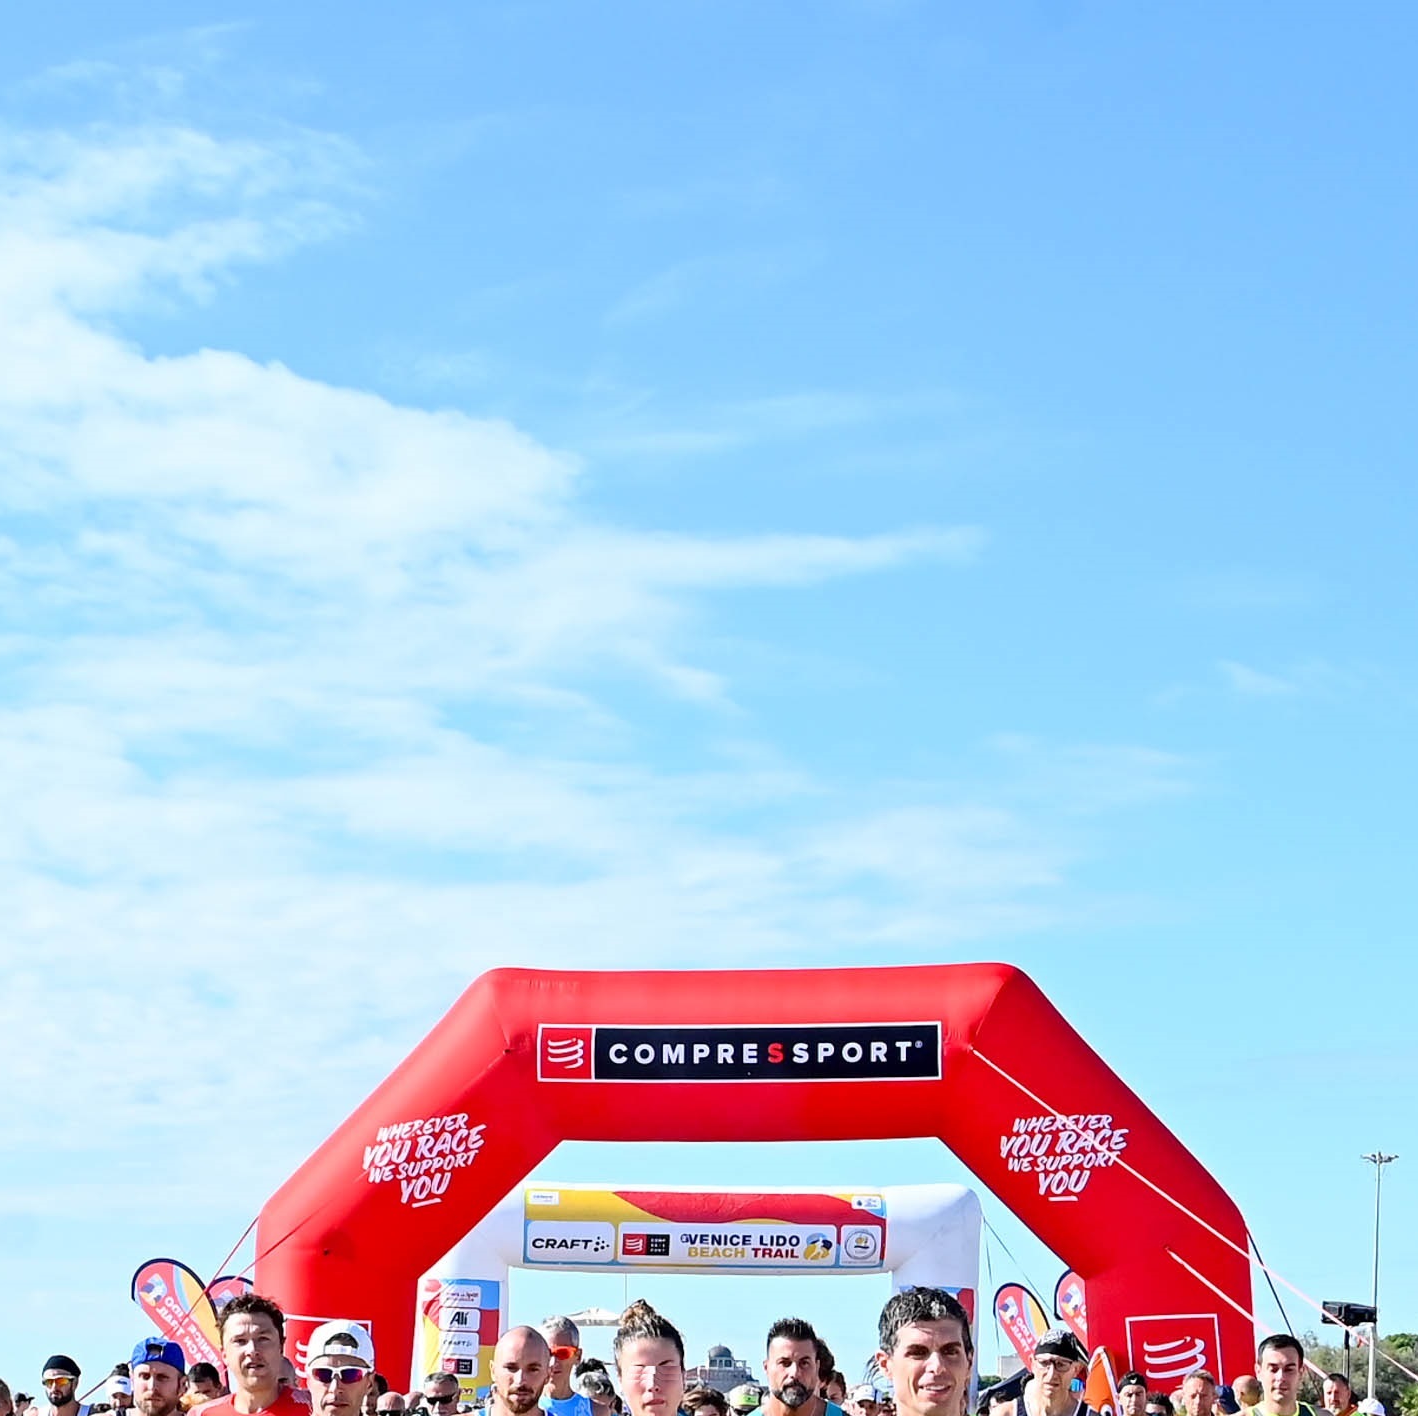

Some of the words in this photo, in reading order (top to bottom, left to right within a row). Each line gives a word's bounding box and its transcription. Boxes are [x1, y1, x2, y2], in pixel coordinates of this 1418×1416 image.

[376, 1113, 468, 1142] WHEREVER
[1012, 1114, 1112, 1133] WHEREVER
[363, 1140, 411, 1170] YOU
[415, 1124, 487, 1158] RACE
[1000, 1133, 1052, 1159] YOU
[1054, 1129, 1129, 1154] RACE
[368, 1164, 396, 1183] WE
[396, 1149, 479, 1180] SUPPORT
[1008, 1157, 1034, 1172] WE
[1034, 1151, 1120, 1172] SUPPORT
[400, 1172, 451, 1204] YOU
[1038, 1169, 1091, 1196] YOU
[532, 1238, 593, 1251] CRAFT
[687, 1246, 745, 1258] BEACH
[751, 1247, 800, 1259] TRAIL
[688, 1233, 751, 1246] VENICE
[759, 1234, 801, 1247] LIDO
